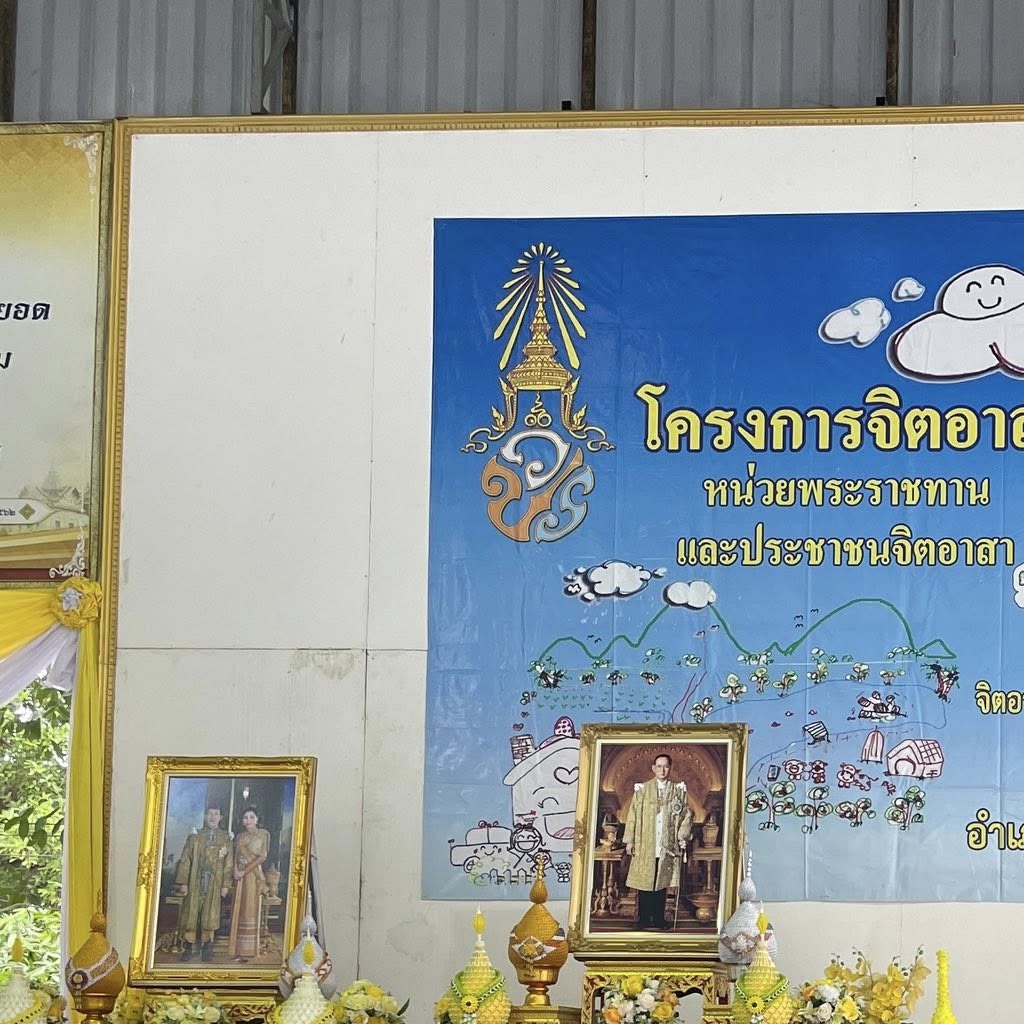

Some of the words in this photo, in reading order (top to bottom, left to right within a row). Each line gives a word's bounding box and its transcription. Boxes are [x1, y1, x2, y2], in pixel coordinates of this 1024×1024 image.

[704, 462, 991, 507] หน่วยพระราชทาน
[677, 524, 1016, 567] และประชาชนจิตอาสา
